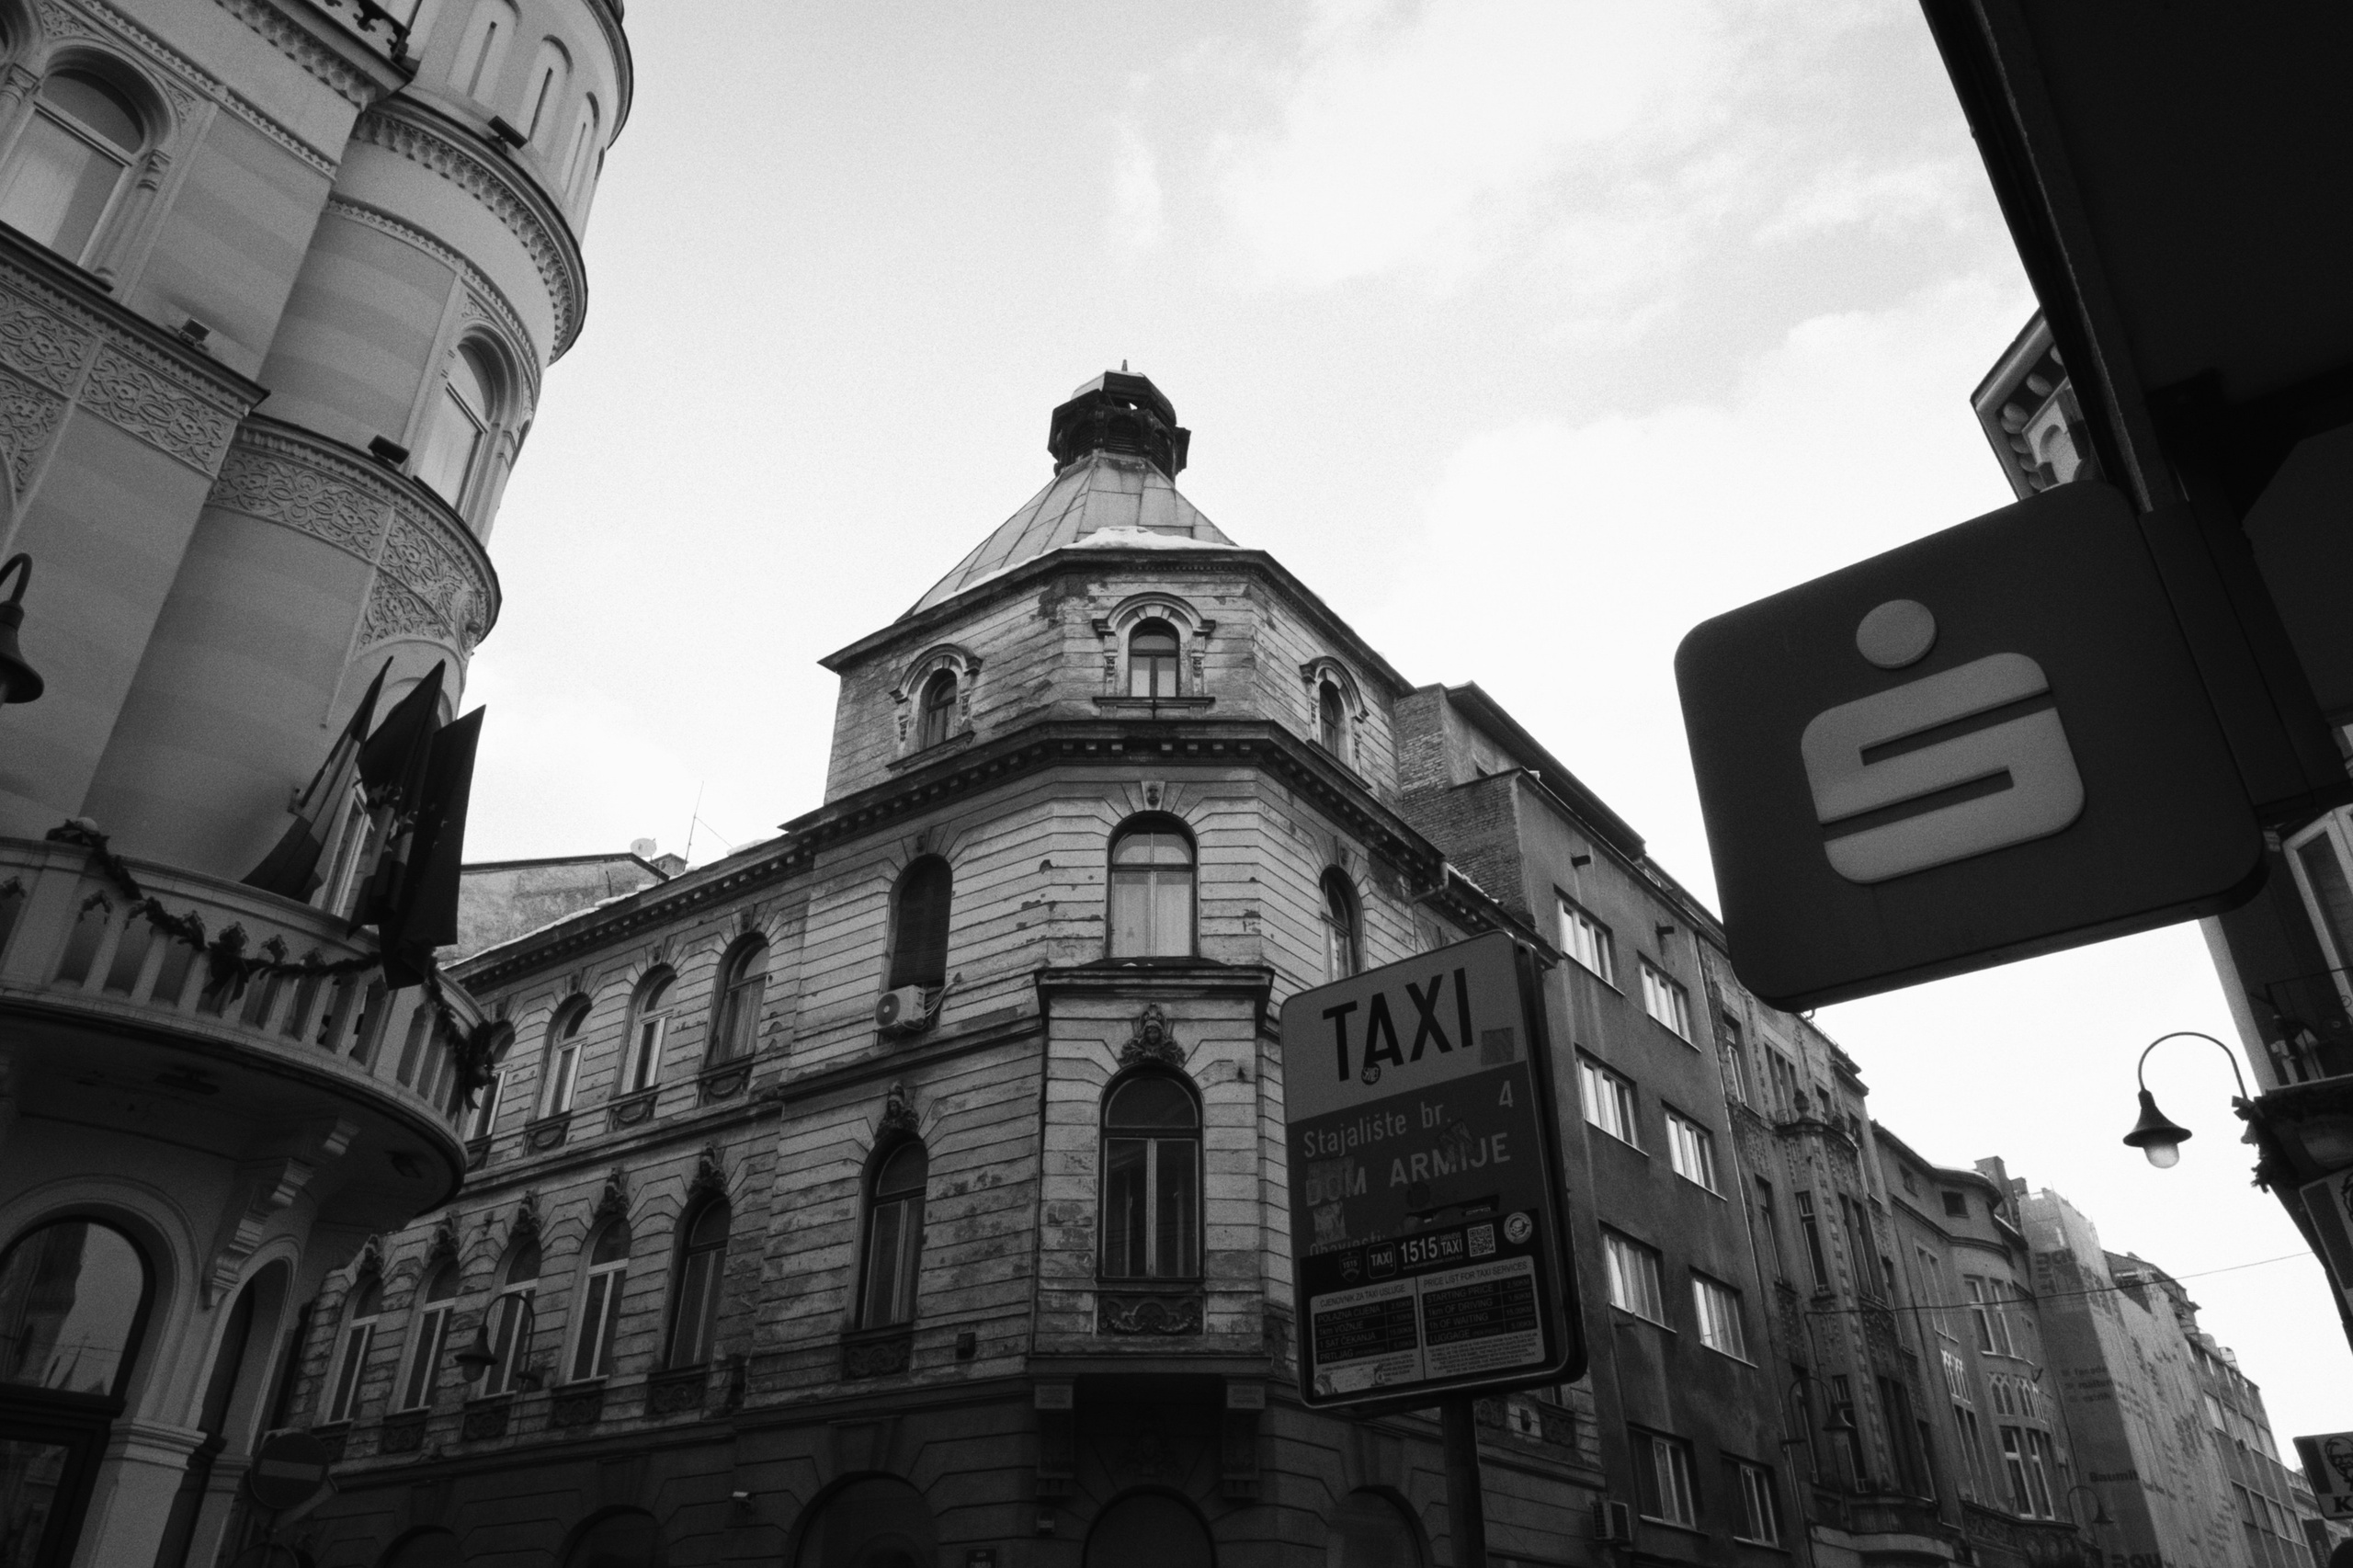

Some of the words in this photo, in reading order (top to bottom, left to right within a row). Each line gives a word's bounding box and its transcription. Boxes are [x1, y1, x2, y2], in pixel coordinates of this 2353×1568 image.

[1322, 967, 1473, 1082] TAXI
[1303, 1113, 1407, 1158] Stajalište
[1421, 1100, 1451, 1130] br.
[1498, 1080, 1514, 1108] 4
[1390, 1132, 1511, 1187] ARMIJE
[1400, 1236, 1438, 1264] 1515
[1440, 1238, 1463, 1256] TAXI
[1342, 1260, 1358, 1269] 1515
[1424, 1276, 1444, 1287] PRICE
[1445, 1274, 1461, 1284] LIST
[1461, 1270, 1475, 1280] FOR
[1476, 1267, 1492, 1278] TAXI
[1493, 1261, 1528, 1275] SERVICES
[1319, 1293, 1356, 1307] CJENOVNIK
[1356, 1292, 1365, 1301] ZA
[1365, 1289, 1379, 1299] TAXI
[1379, 1284, 1405, 1297] USLUGE
[1426, 1288, 1468, 1303] STARTING
[1468, 1283, 1494, 1295] PRICE
[1317, 1310, 1352, 1324] POLAZNA
[1353, 1305, 1381, 1317] CIJENA
[1427, 1307, 1443, 1317] 1km
[1444, 1303, 1456, 1314] OF
[1458, 1297, 1493, 1312] DRIVING
[1319, 1327, 1334, 1336] 1km
[1334, 1320, 1364, 1332] VOŽNJE
[1428, 1320, 1438, 1330] 1h
[1439, 1317, 1451, 1329] OF
[1452, 1312, 1489, 1326] WAITING
[1324, 1337, 1339, 1347] SAT
[1340, 1331, 1377, 1345] ČEKANJA
[1429, 1328, 1471, 1344] LUGGAGE
[1320, 1348, 1354, 1362] PRTLJAG
